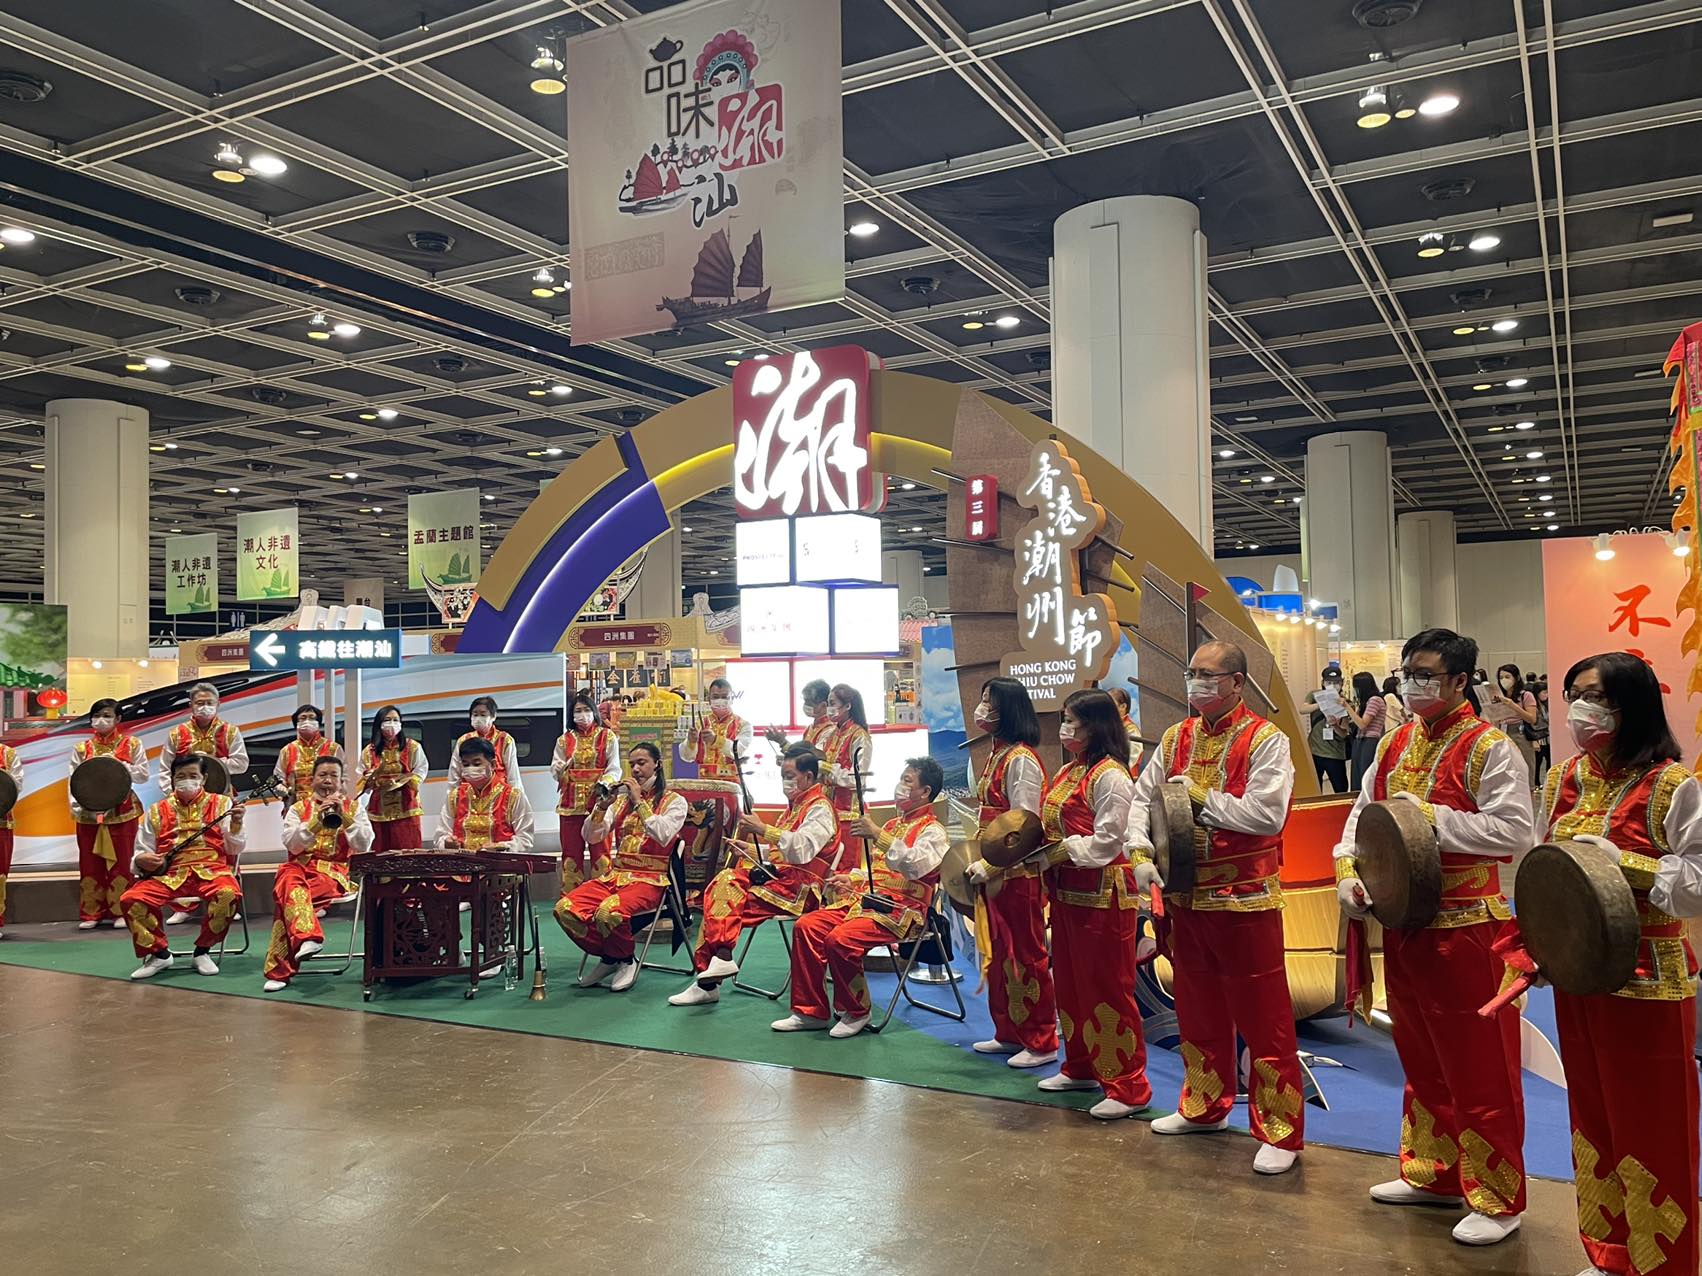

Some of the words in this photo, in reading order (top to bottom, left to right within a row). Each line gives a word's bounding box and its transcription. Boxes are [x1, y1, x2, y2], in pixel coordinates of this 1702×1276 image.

[414, 525, 474, 545] 盂蘭主題館
[243, 534, 291, 554] 潮人非遺
[171, 556, 212, 573] 潮人非遺
[256, 554, 279, 570] 文化
[177, 573, 207, 588] 工作坊
[298, 640, 392, 659] 高鐵往潮汕
[1010, 662, 1042, 676] HONG
[1044, 659, 1076, 672] KONG
[1017, 677, 1038, 687] HIU
[1040, 673, 1075, 686] CHOW
[1027, 688, 1056, 700] TIVAL
